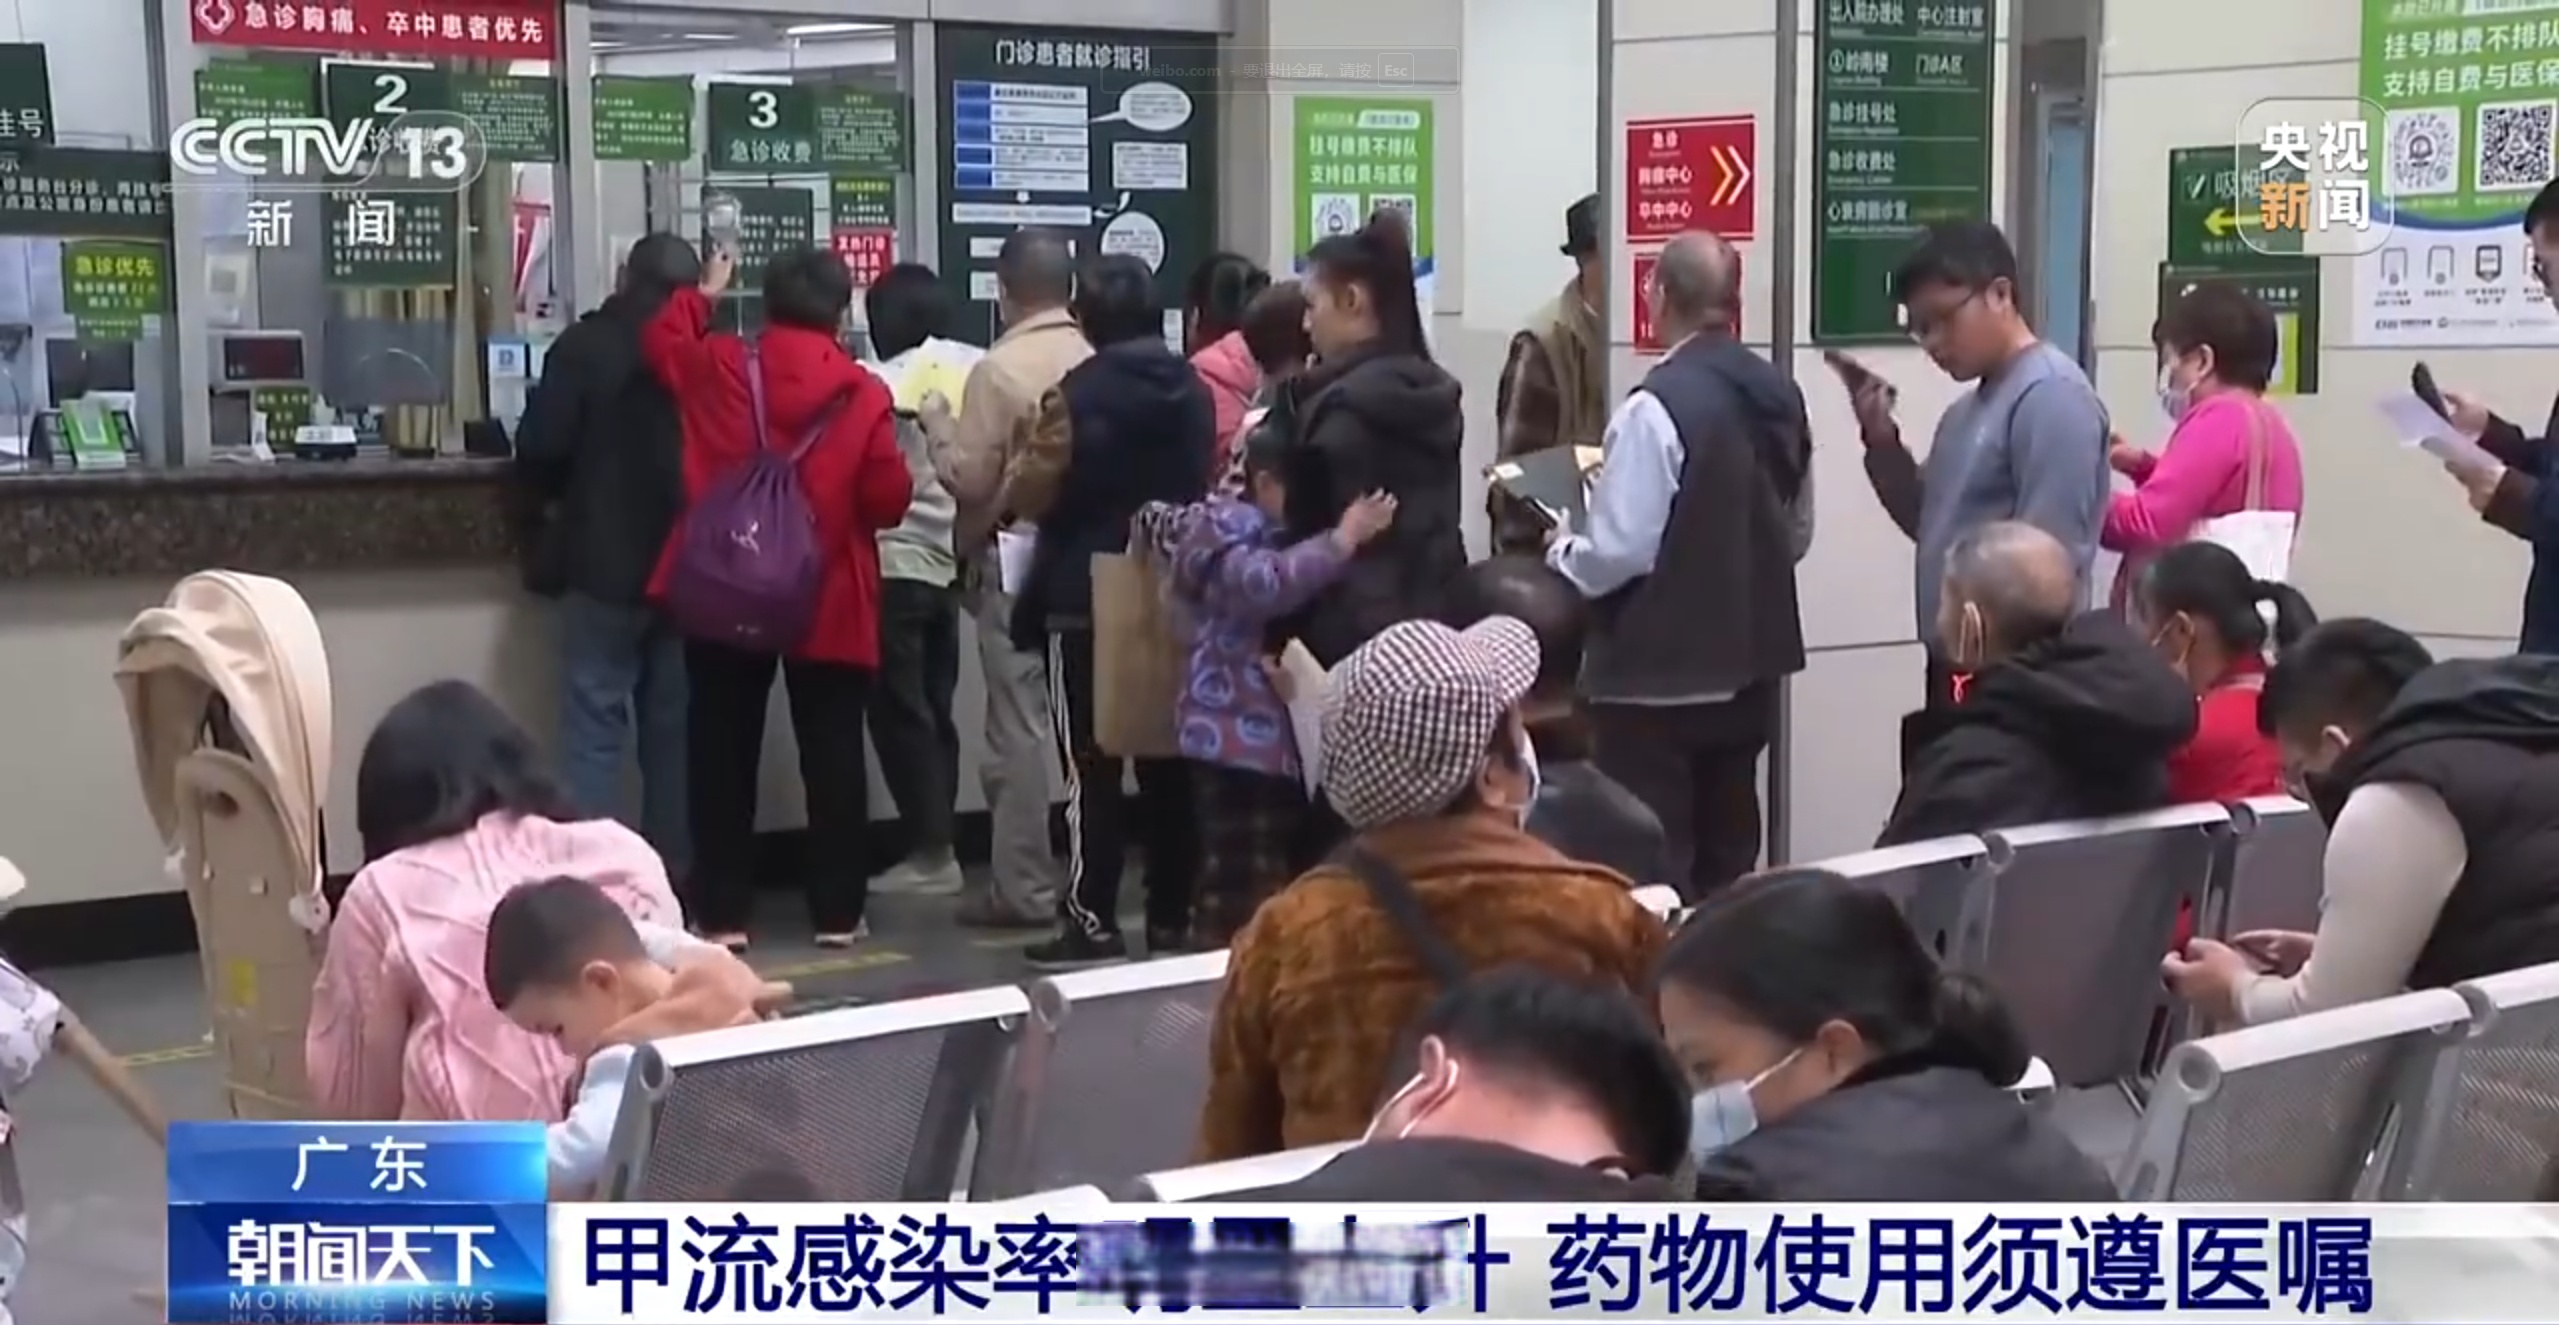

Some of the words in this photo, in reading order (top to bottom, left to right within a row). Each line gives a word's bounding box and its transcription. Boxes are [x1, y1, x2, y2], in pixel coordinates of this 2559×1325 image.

[244, 3, 544, 43] 急诊胸痛、卒中患者优先
[996, 40, 1152, 71] 门诊患者就诊指引
[2384, 22, 2559, 58] 挂号缴费不排队
[373, 75, 409, 114] 2
[2383, 61, 2559, 97] 支持自费与医保
[748, 91, 779, 129] 3
[730, 139, 813, 164] 急诊收费
[1652, 130, 1678, 149] 急诊
[1310, 163, 1418, 185] 支持自费与医保
[76, 255, 155, 277] 急诊优先
